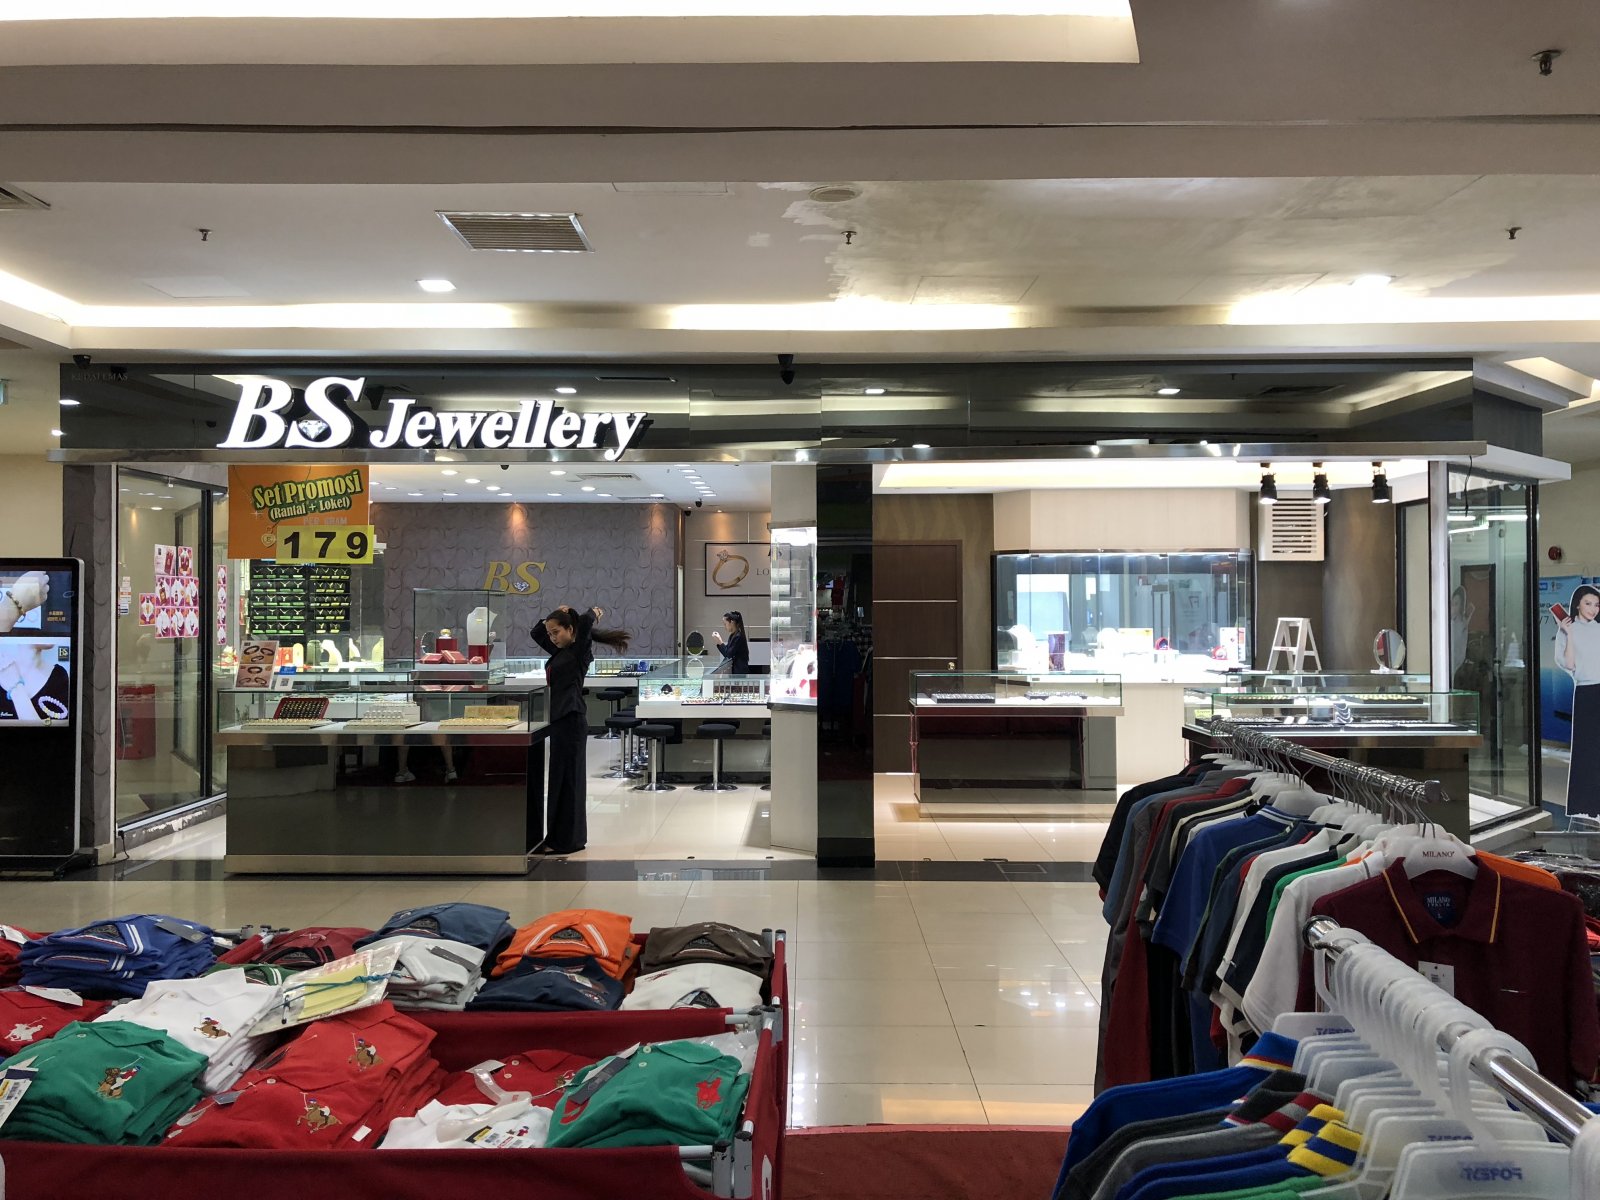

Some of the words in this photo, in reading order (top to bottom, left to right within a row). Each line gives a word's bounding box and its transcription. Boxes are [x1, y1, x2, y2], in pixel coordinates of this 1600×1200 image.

[216, 375, 366, 448] BS
[369, 398, 647, 461] Jewellery
[253, 485, 283, 508] Set
[284, 471, 362, 504] Promosi
[483, 561, 546, 595] BS
[1422, 850, 1455, 858] MILANO
[1426, 896, 1451, 904] MILANO
